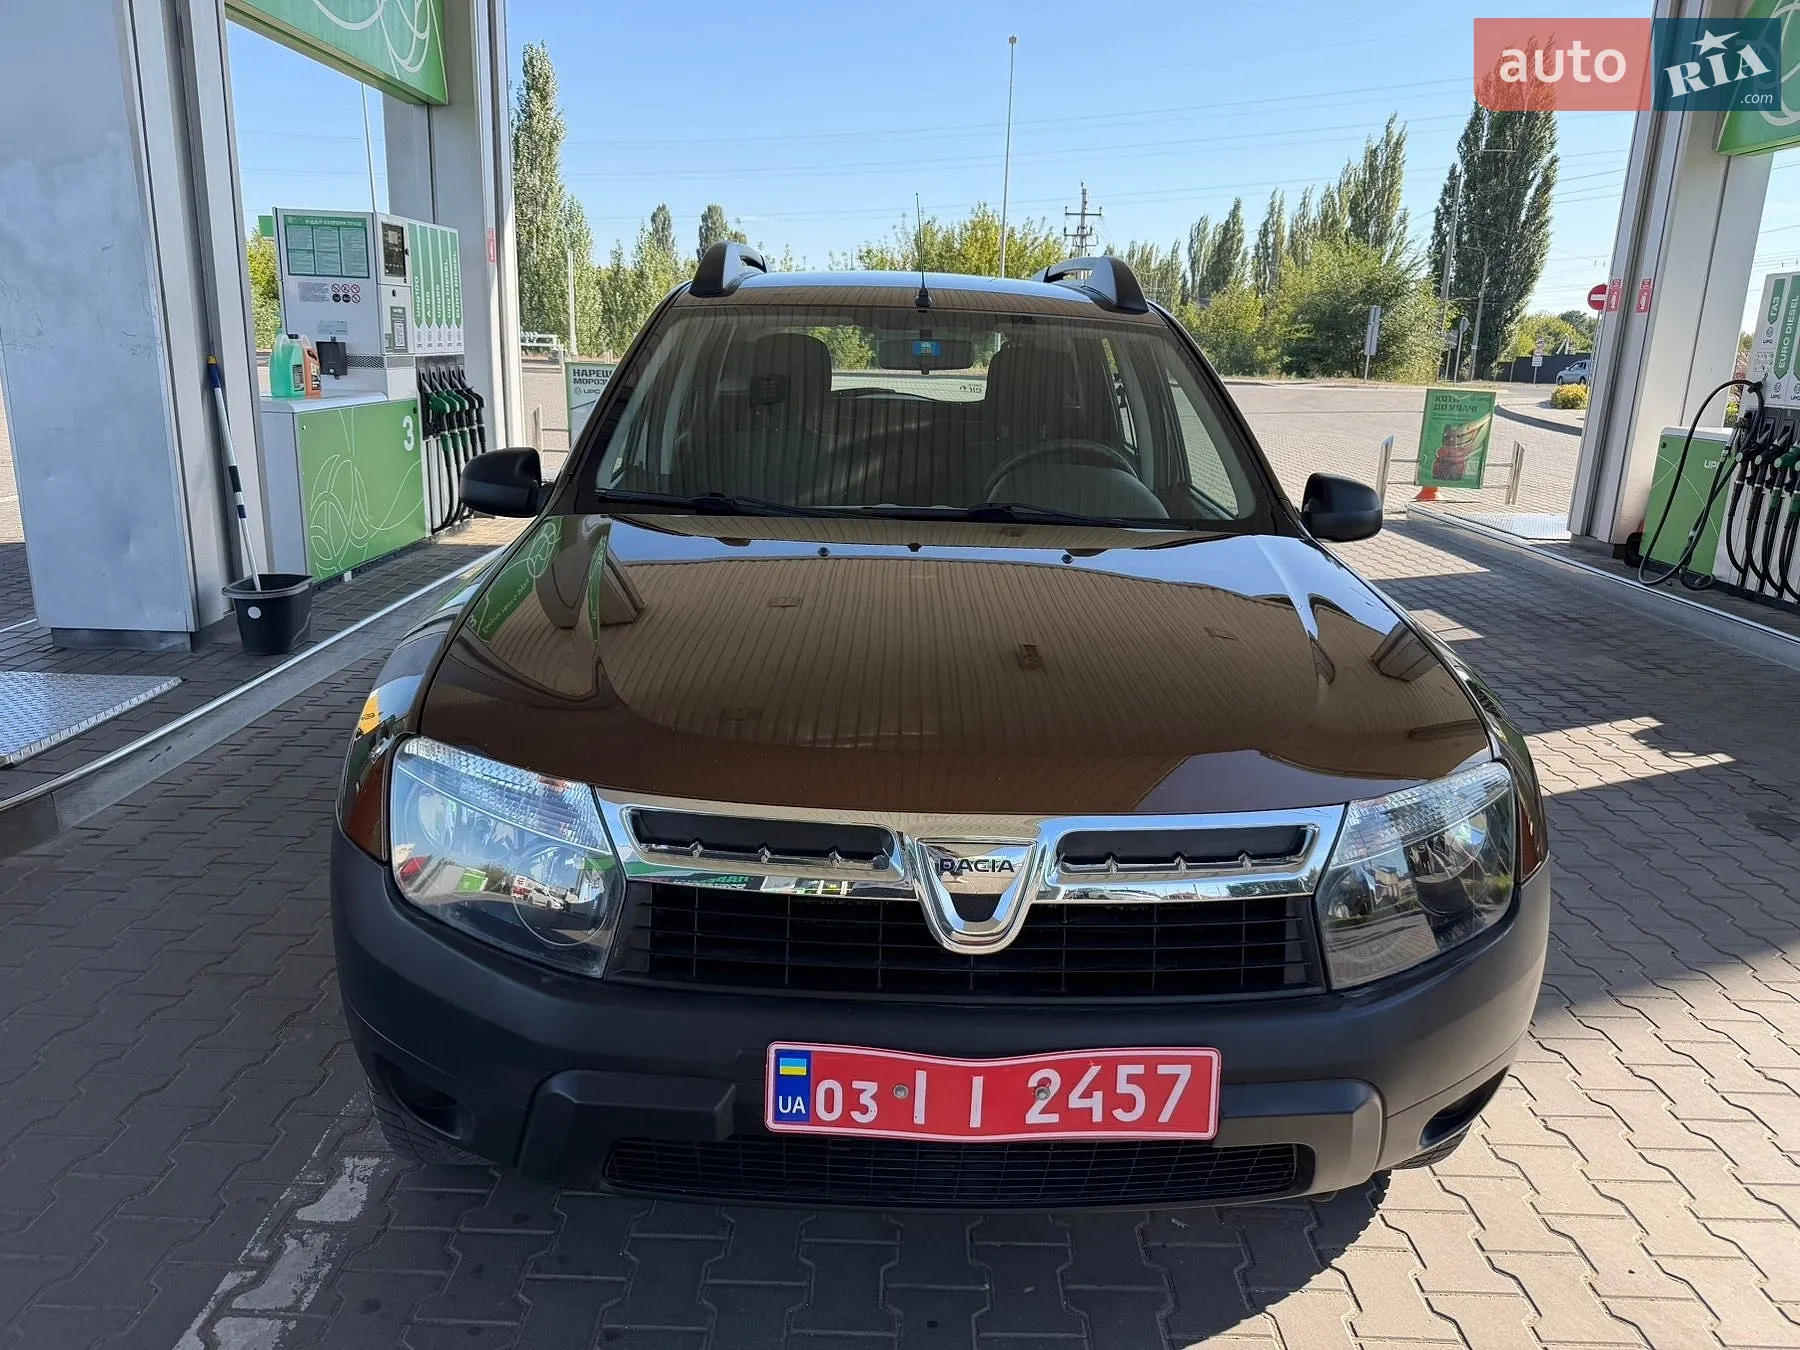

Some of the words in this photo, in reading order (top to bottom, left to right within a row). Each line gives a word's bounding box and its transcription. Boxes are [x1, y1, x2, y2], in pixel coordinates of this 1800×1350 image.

[1771, 296, 1779, 316] ГАЗ
[1784, 295, 1799, 334] DIESEL
[1779, 337, 1790, 368] EURO
[402, 415, 415, 452] 3
[937, 858, 1015, 873] DACIA
[778, 1096, 806, 1115] UA
[815, 1079, 878, 1124] 03
[1025, 1063, 1193, 1125] 2457
